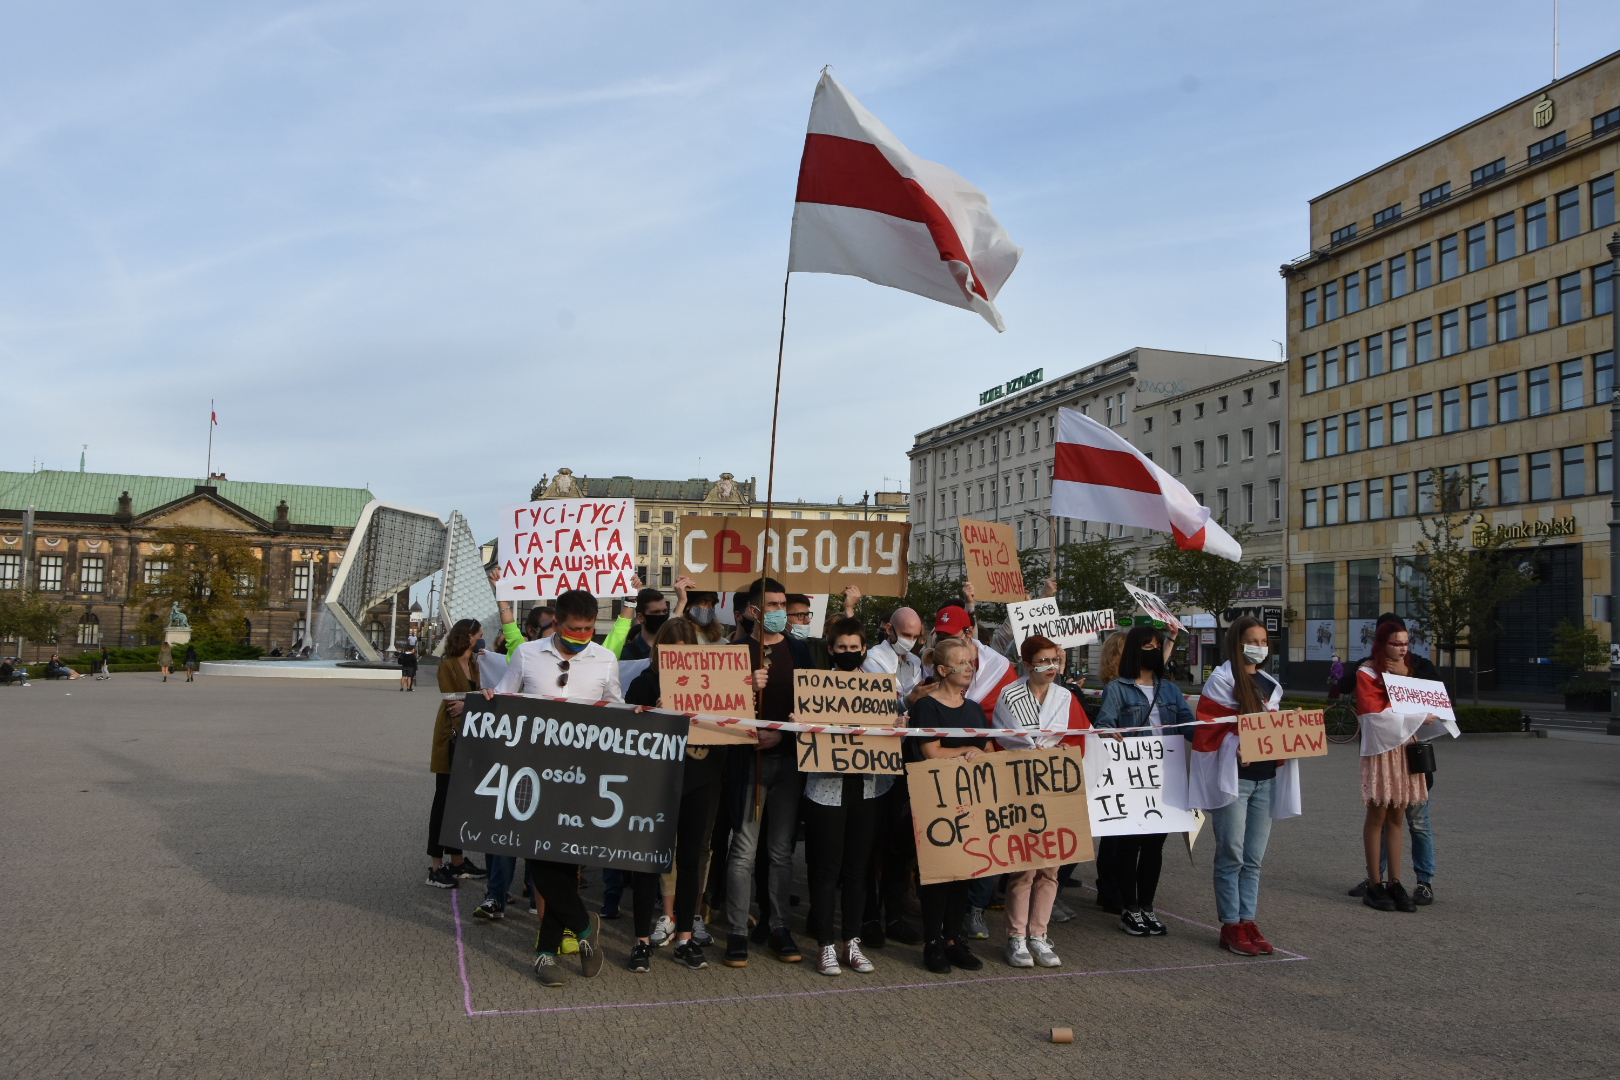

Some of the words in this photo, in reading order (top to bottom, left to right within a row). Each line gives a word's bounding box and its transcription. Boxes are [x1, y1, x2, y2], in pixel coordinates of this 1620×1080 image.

[979, 385, 1005, 405] HOTEL
[514, 501, 627, 529] ГУСІ-ГУСІ
[1532, 515, 1575, 537] Polski
[514, 527, 623, 555] ГА-ГА-ГА
[683, 527, 902, 575] СВАБОДУ
[503, 552, 633, 578] ЛУКАШЭНКА
[969, 548, 993, 567] ТЫ
[986, 570, 1025, 596] УВОЛЕН
[1014, 606, 1025, 621] 5
[1021, 611, 1114, 640] ZAMORDOWANYCH
[1223, 606, 1262, 622] OPTY
[660, 650, 749, 671] ПРАСТЫТУТКІ
[797, 674, 893, 693] ПОЛЬСКАЯ
[673, 692, 747, 712] НАРОДАМ
[1240, 716, 1266, 732] ALL
[1269, 712, 1295, 729] WE
[1298, 712, 1325, 727] NEED
[462, 710, 527, 747] KRAJ
[530, 716, 689, 762] PROSPOŁECZNY
[796, 730, 819, 768] Я
[829, 723, 864, 746] НЕ
[1257, 735, 1274, 755] IS
[1282, 731, 1324, 753] LAW
[831, 747, 904, 772] БОЮСЬ
[541, 765, 587, 785] osób
[928, 769, 948, 808] I
[955, 762, 998, 806] AM
[1005, 755, 1082, 796] TIRED
[1127, 764, 1162, 788] НЕ
[474, 762, 541, 822] 40
[590, 774, 629, 828] 5
[557, 812, 585, 828] na
[926, 811, 970, 847] OF
[490, 830, 522, 847] celi
[534, 839, 551, 855] po
[962, 827, 1078, 878] SCARED
